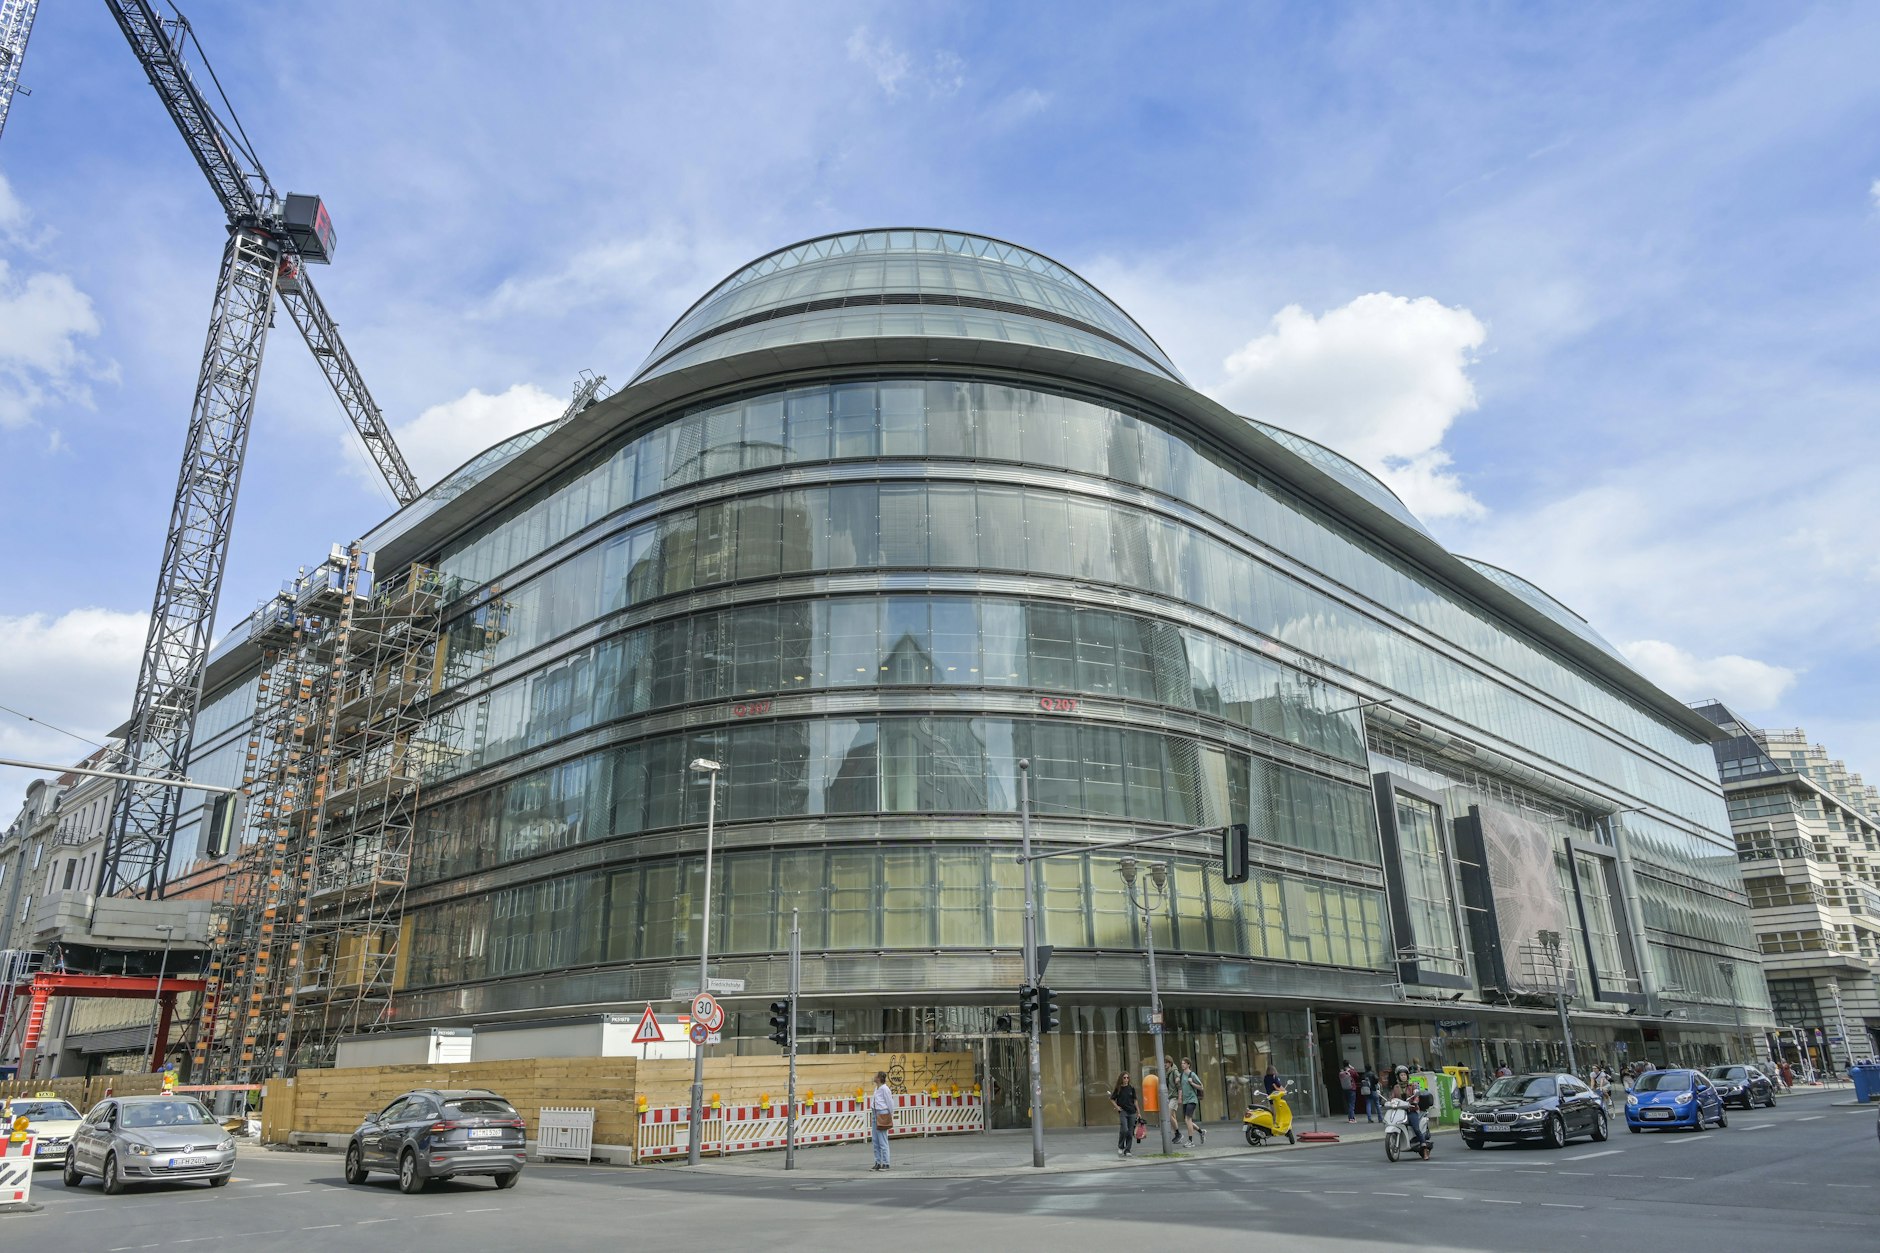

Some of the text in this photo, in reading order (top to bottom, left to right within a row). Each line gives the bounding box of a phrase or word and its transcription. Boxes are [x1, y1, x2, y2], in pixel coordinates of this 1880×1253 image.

[734, 703, 747, 717] Q
[1041, 697, 1076, 711] Q 207
[697, 1001, 712, 1015] 30
